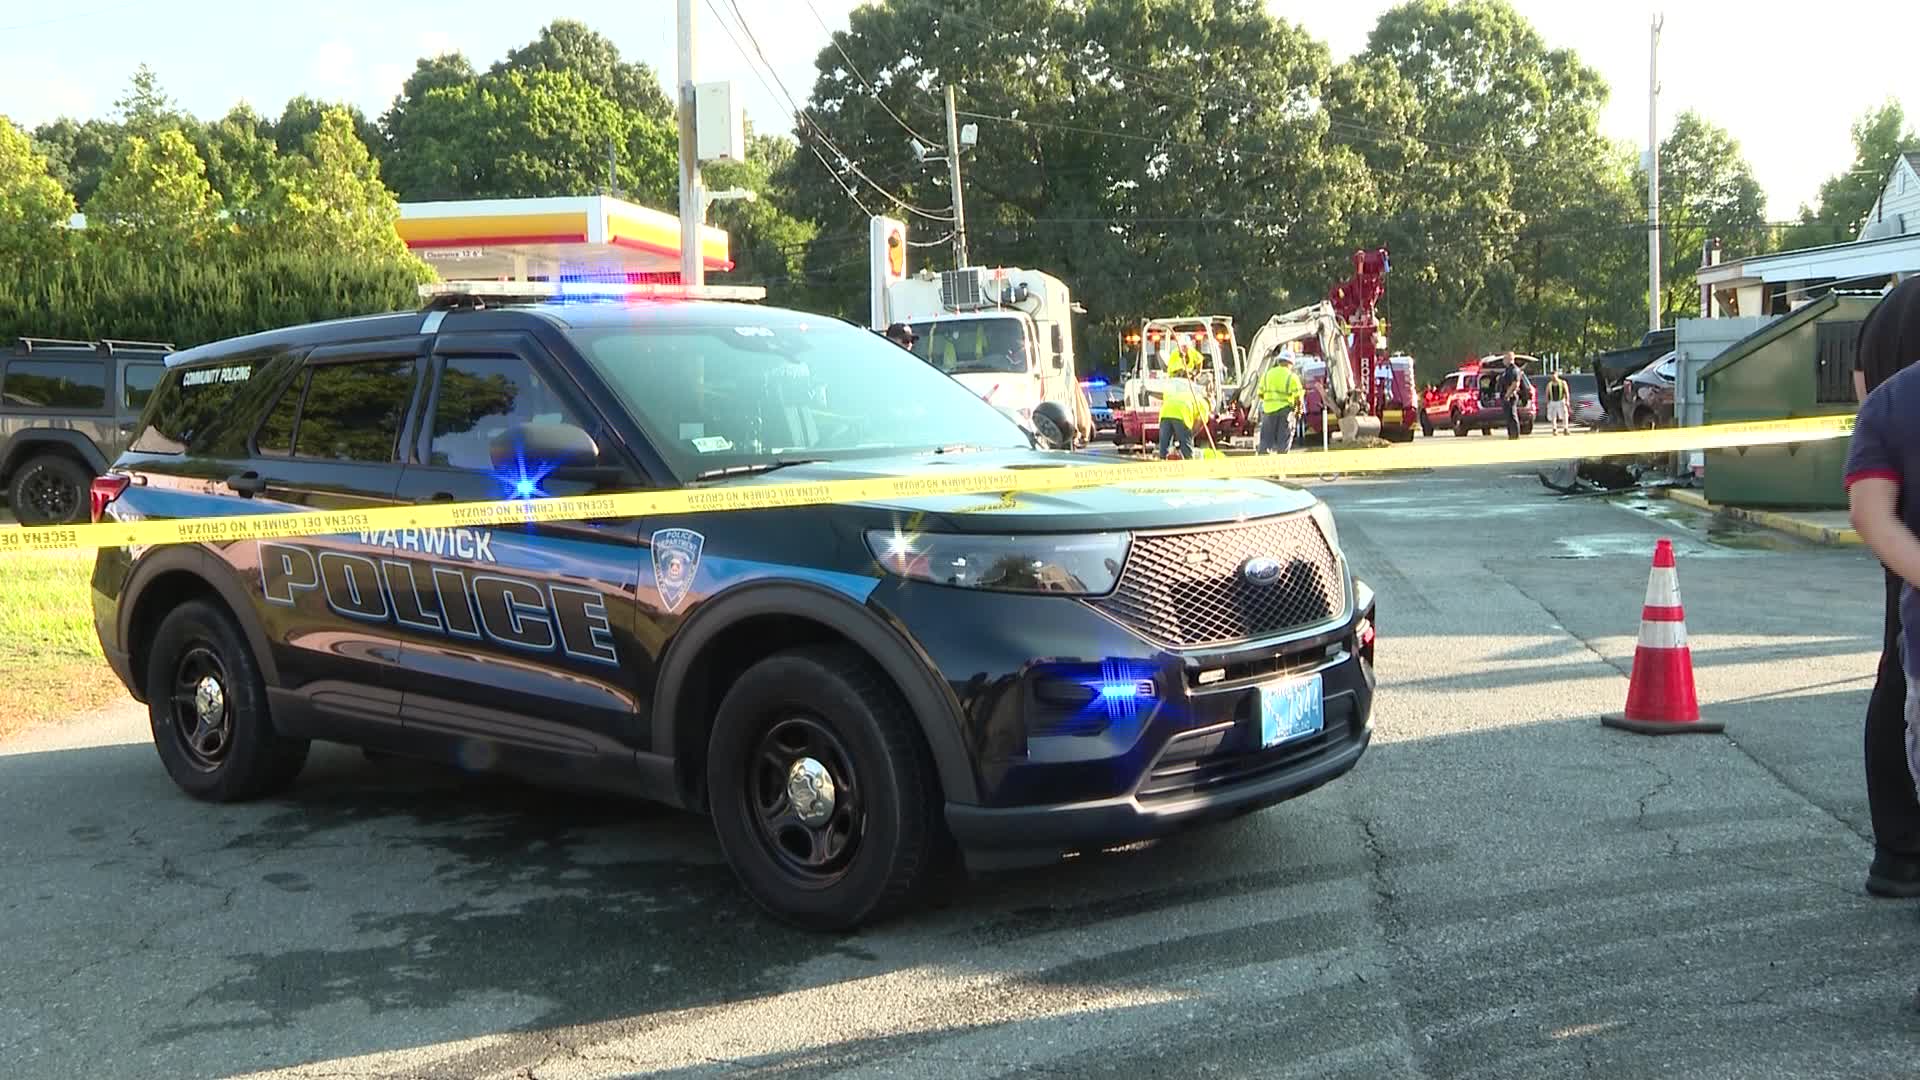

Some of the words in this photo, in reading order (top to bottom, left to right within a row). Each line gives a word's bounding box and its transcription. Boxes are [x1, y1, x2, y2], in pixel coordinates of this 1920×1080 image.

[182, 368, 220, 387] COMMUNITY
[220, 364, 252, 383] POLICING
[688, 494, 723, 503] CRUZAR
[726, 492, 738, 501] NO
[743, 490, 776, 500] CRIMEN
[496, 506, 510, 515] NO
[516, 503, 553, 514] CRIMEN
[558, 502, 574, 512] DEL
[577, 499, 614, 511] ESCENA
[452, 507, 493, 518] CRUZAR
[254, 518, 296, 530] CRIMEN
[301, 517, 320, 528] DEL
[324, 514, 368, 526] ESCENA
[178, 522, 226, 535] CRUZAR
[230, 522, 246, 532] NO
[23, 531, 76, 544] ESCENA
[360, 526, 495, 562] WARWICK
[657, 539, 697, 552] DEPARTMENT
[258, 540, 621, 666] POLICE
